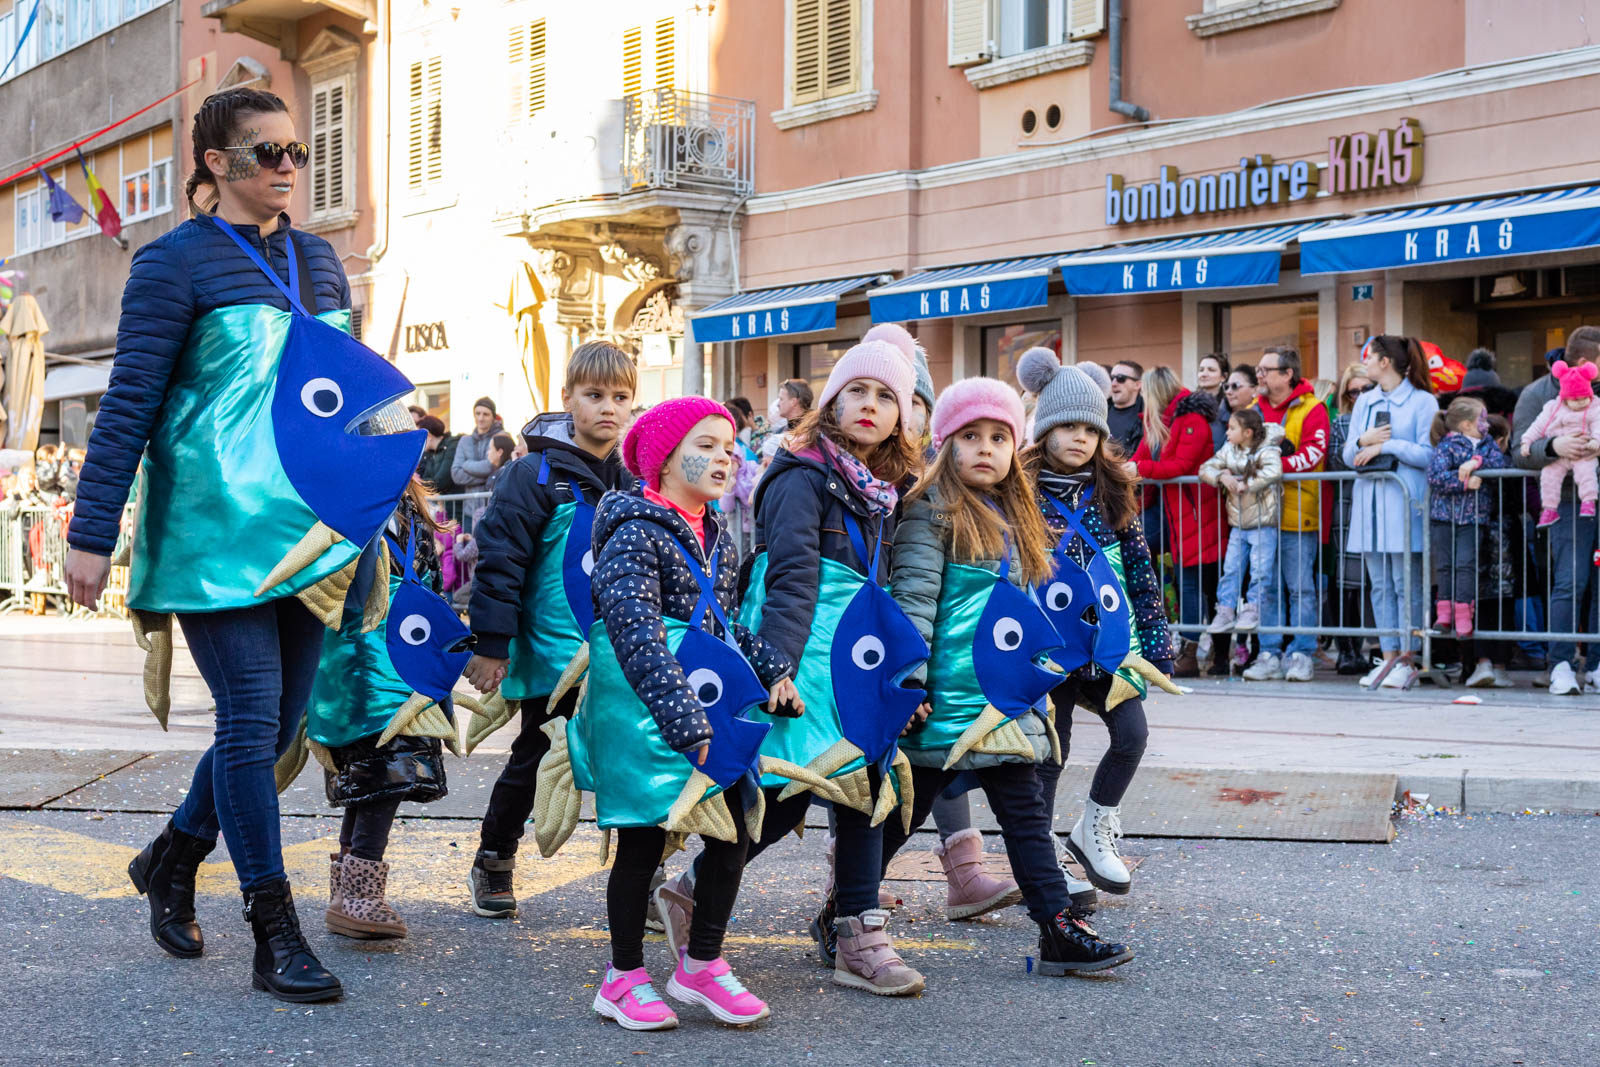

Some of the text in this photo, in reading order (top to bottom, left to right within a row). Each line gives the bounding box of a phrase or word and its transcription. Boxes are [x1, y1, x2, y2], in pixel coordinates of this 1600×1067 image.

[1106, 117, 1414, 225] bonbonnière KRAŠ
[1405, 218, 1513, 261] KRAŠ
[1123, 256, 1208, 290] KRAŠ
[920, 283, 990, 316] KRAŠ
[405, 321, 449, 353] LISCA
[732, 307, 789, 337] KRAŠ
